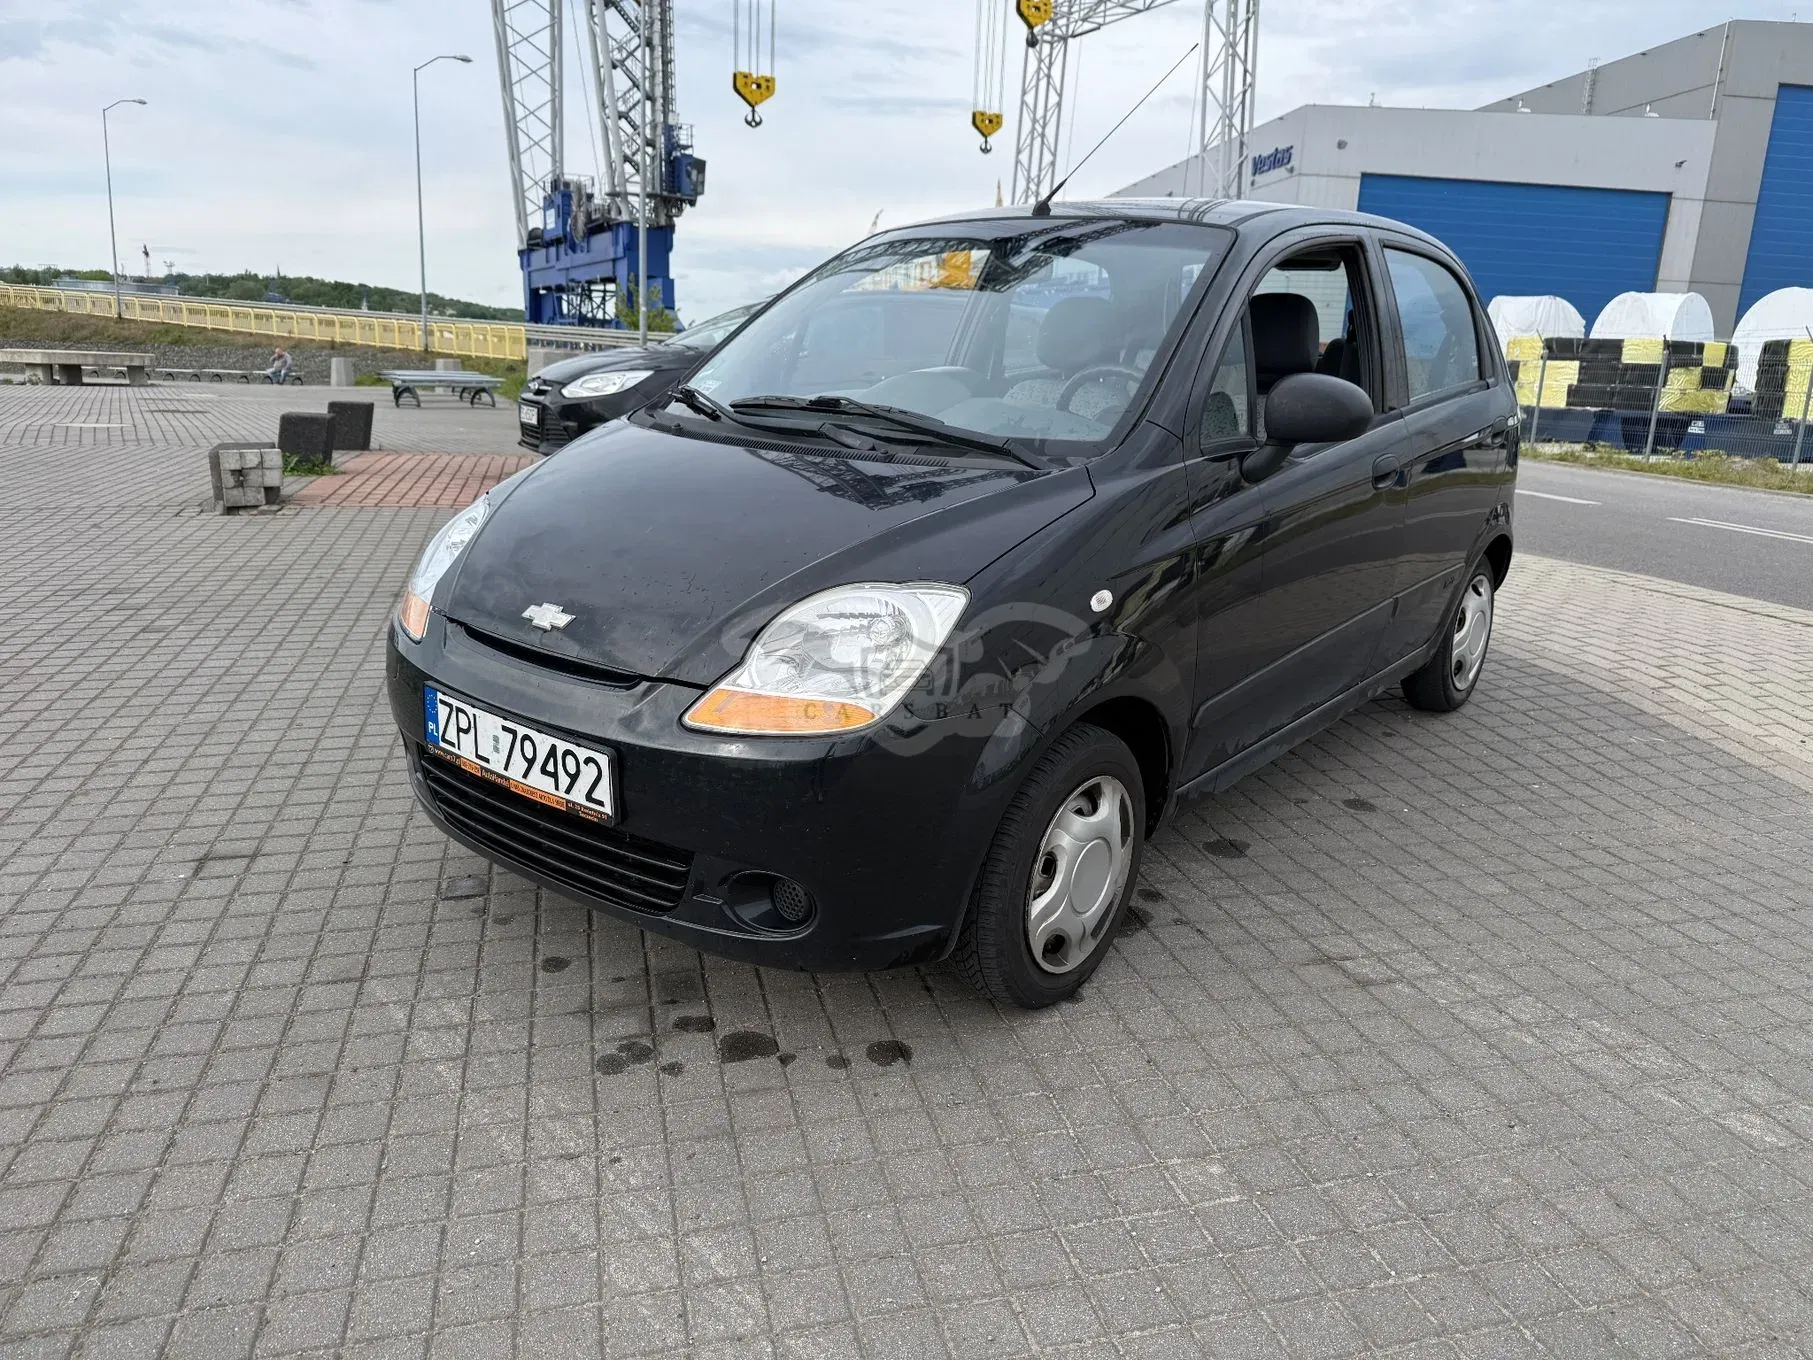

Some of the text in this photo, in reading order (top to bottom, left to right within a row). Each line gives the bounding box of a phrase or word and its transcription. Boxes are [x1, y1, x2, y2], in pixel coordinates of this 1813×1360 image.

[1252, 145, 1294, 177] Vestas
[428, 721, 438, 737] PL
[439, 698, 490, 764] ZPL
[501, 724, 605, 808] 79492
